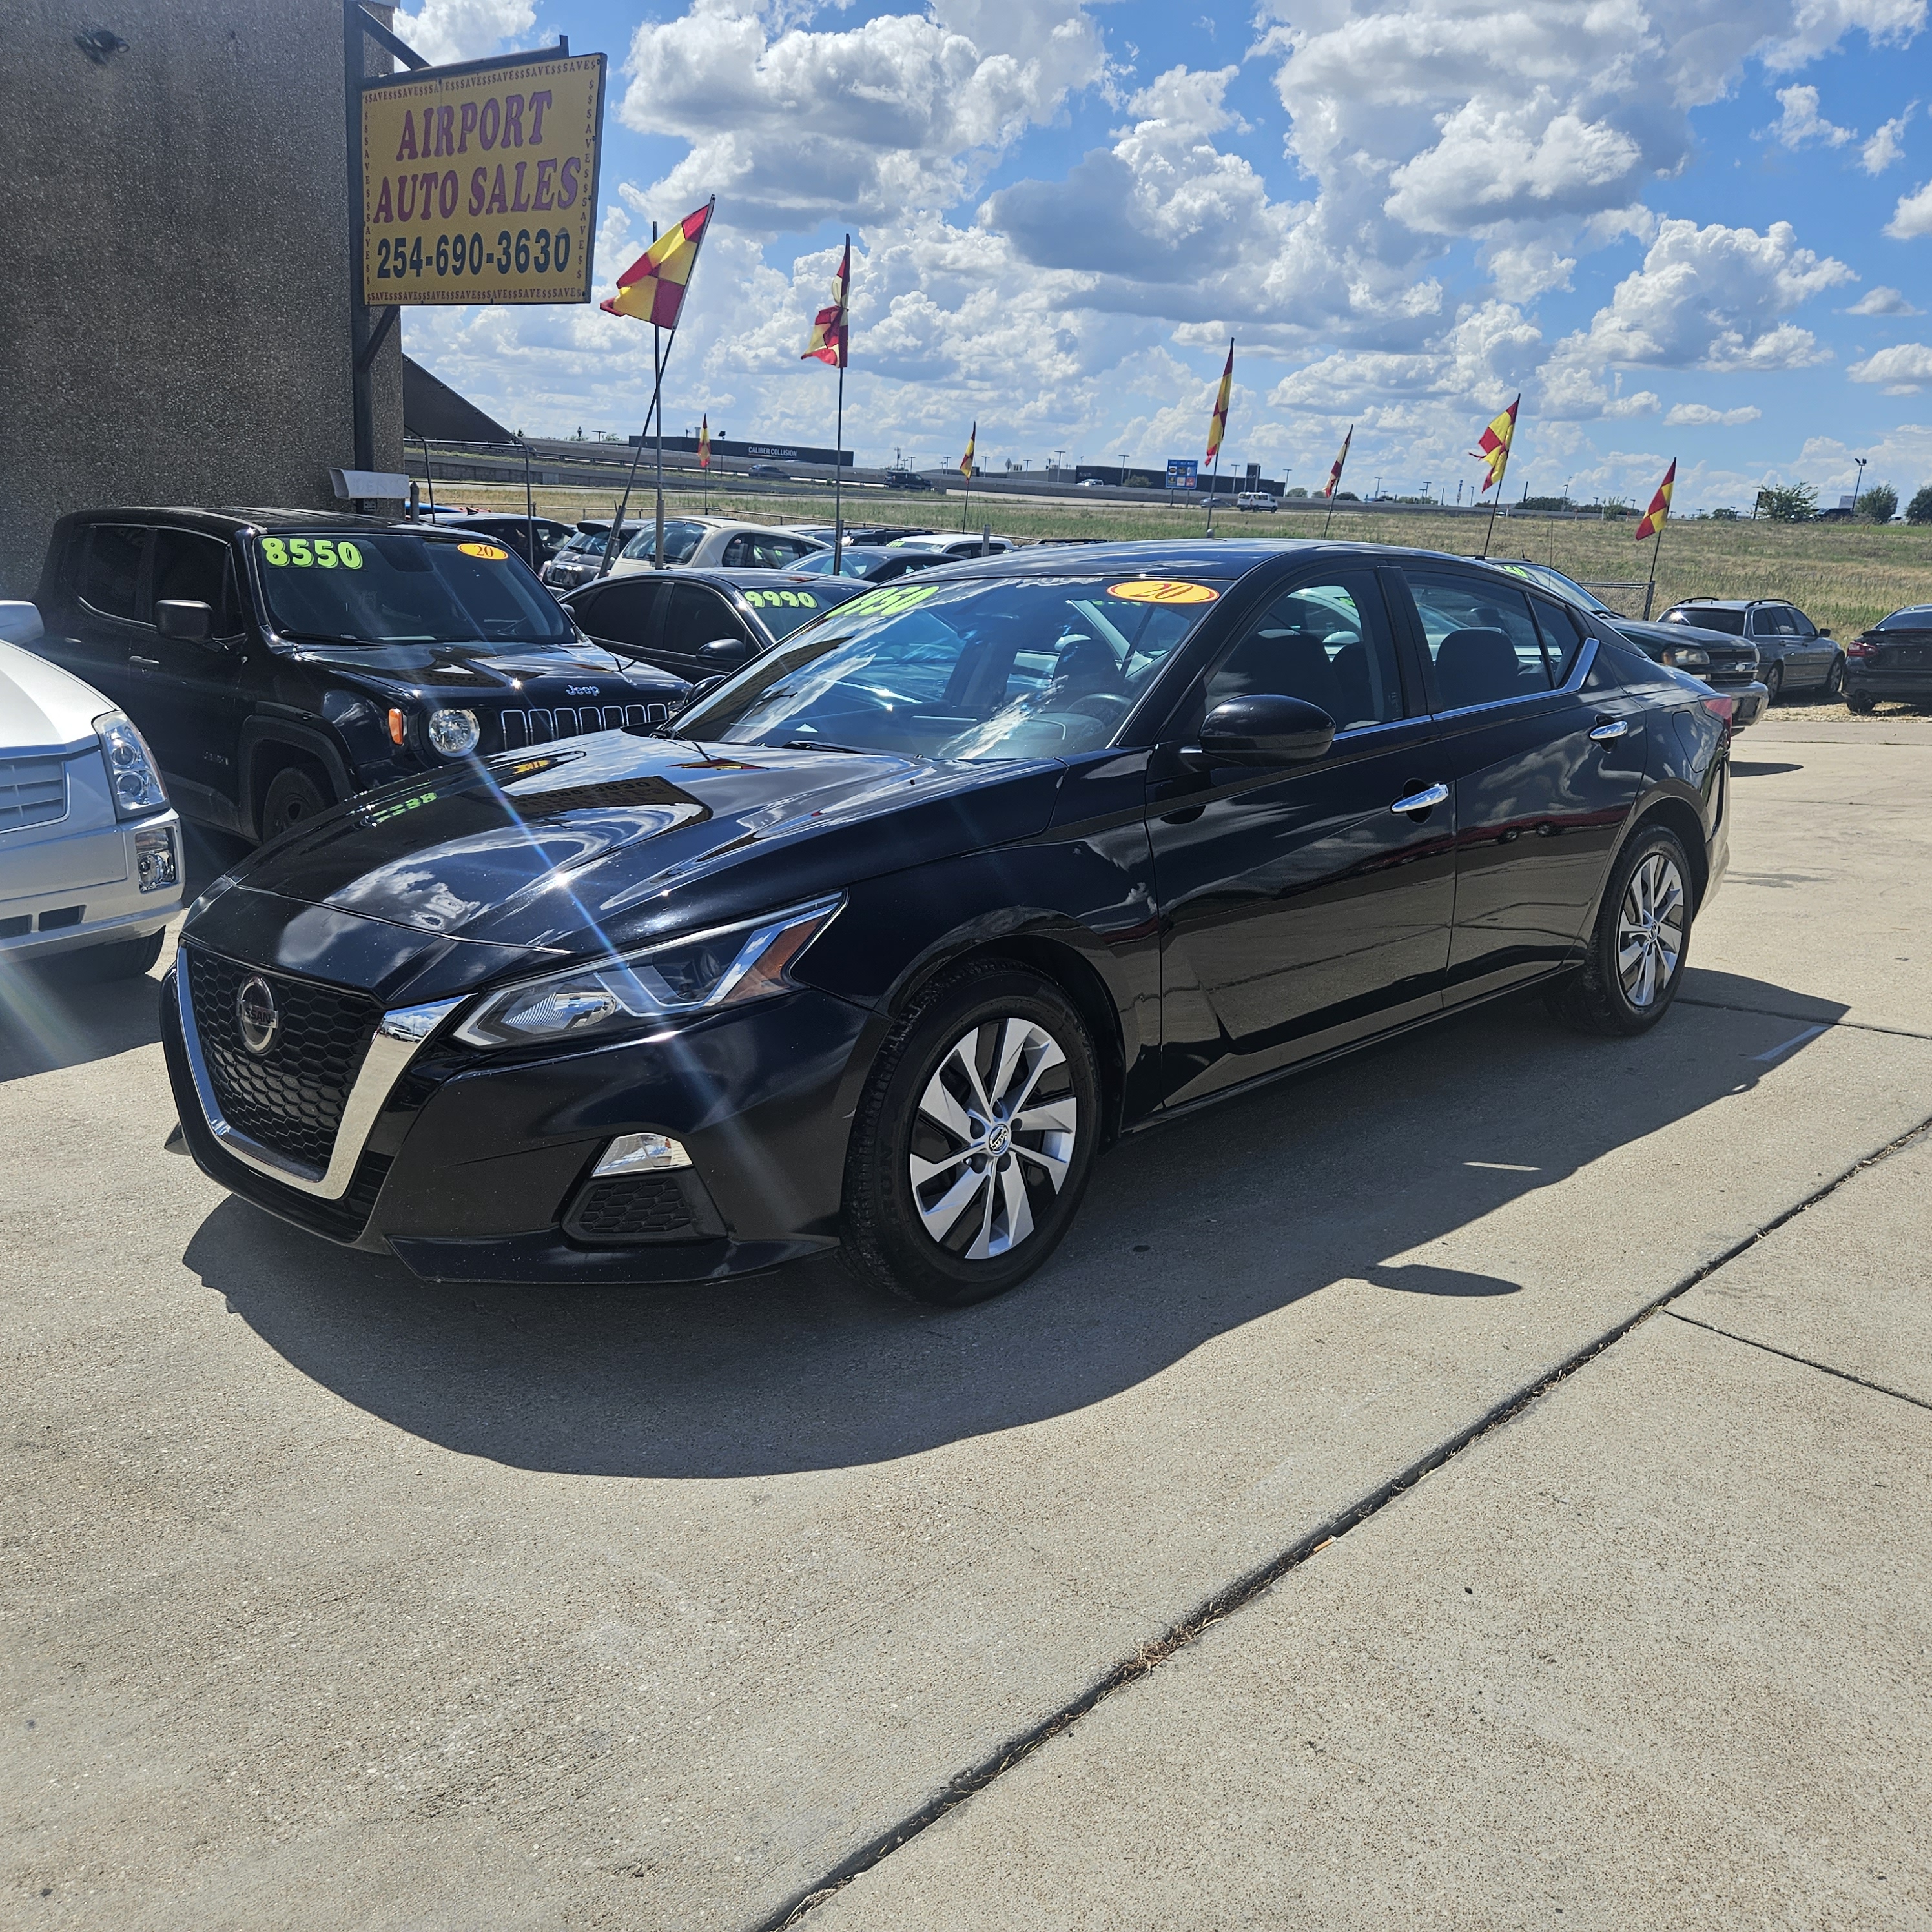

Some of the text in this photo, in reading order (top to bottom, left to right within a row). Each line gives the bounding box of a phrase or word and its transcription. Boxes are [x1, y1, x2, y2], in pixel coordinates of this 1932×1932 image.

[396, 89, 552, 161] AIRPORT
[373, 157, 581, 223] AUTO SALES
[377, 227, 570, 278] 254-690-3630
[748, 446, 797, 457] CALIBER COLLISION
[262, 537, 363, 570] 8550
[473, 545, 494, 558] 20
[745, 590, 817, 608] 9990
[1129, 583, 1194, 599] 20
[566, 684, 600, 697] Jeep
